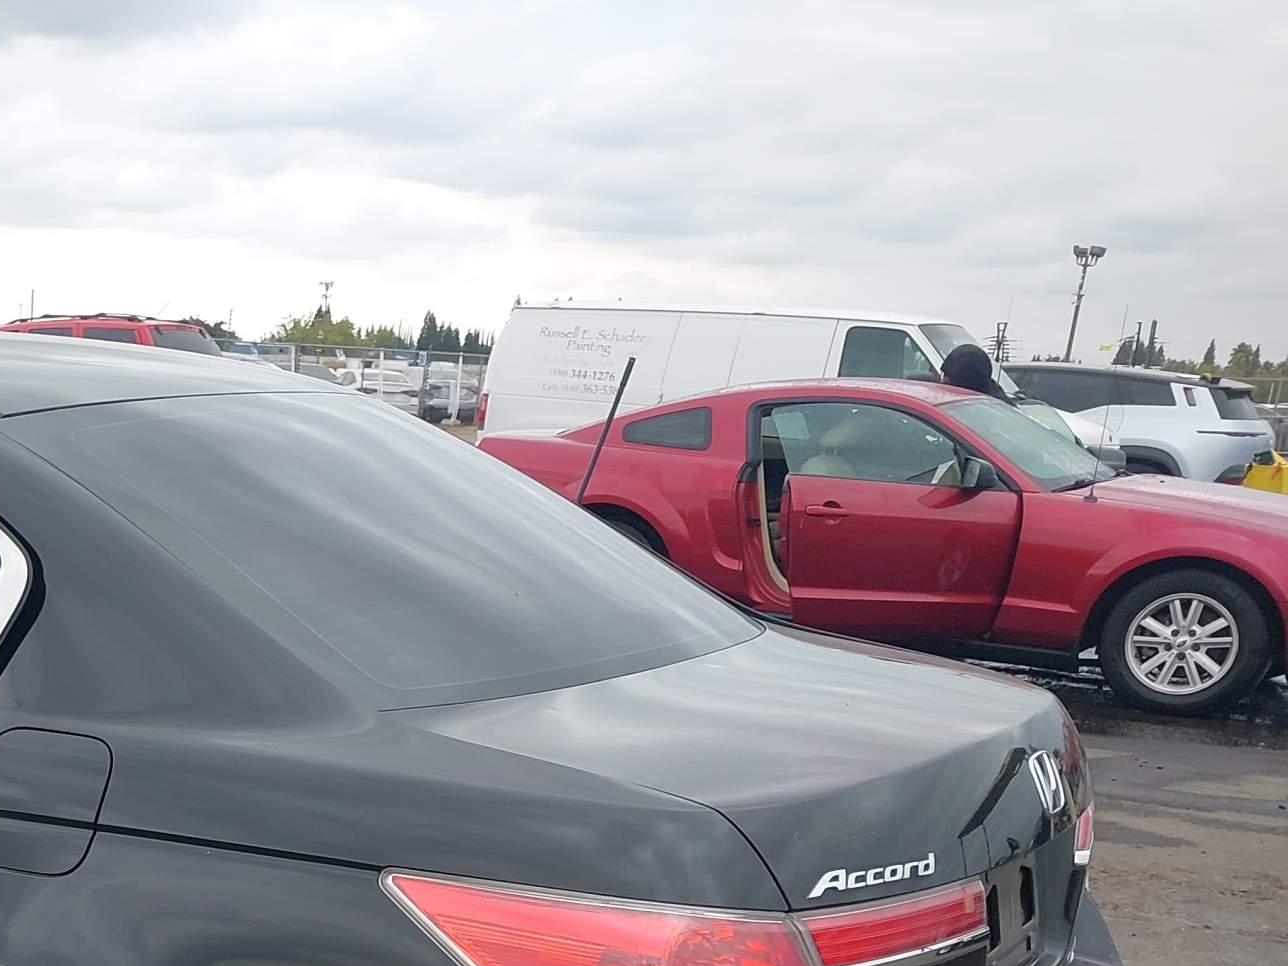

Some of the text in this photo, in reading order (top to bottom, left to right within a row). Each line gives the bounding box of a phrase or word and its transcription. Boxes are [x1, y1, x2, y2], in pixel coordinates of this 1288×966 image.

[539, 326, 581, 338] Russell
[566, 339, 612, 358] Paintng
[569, 369, 616, 382] 344-1276
[807, 852, 936, 900] Accord
